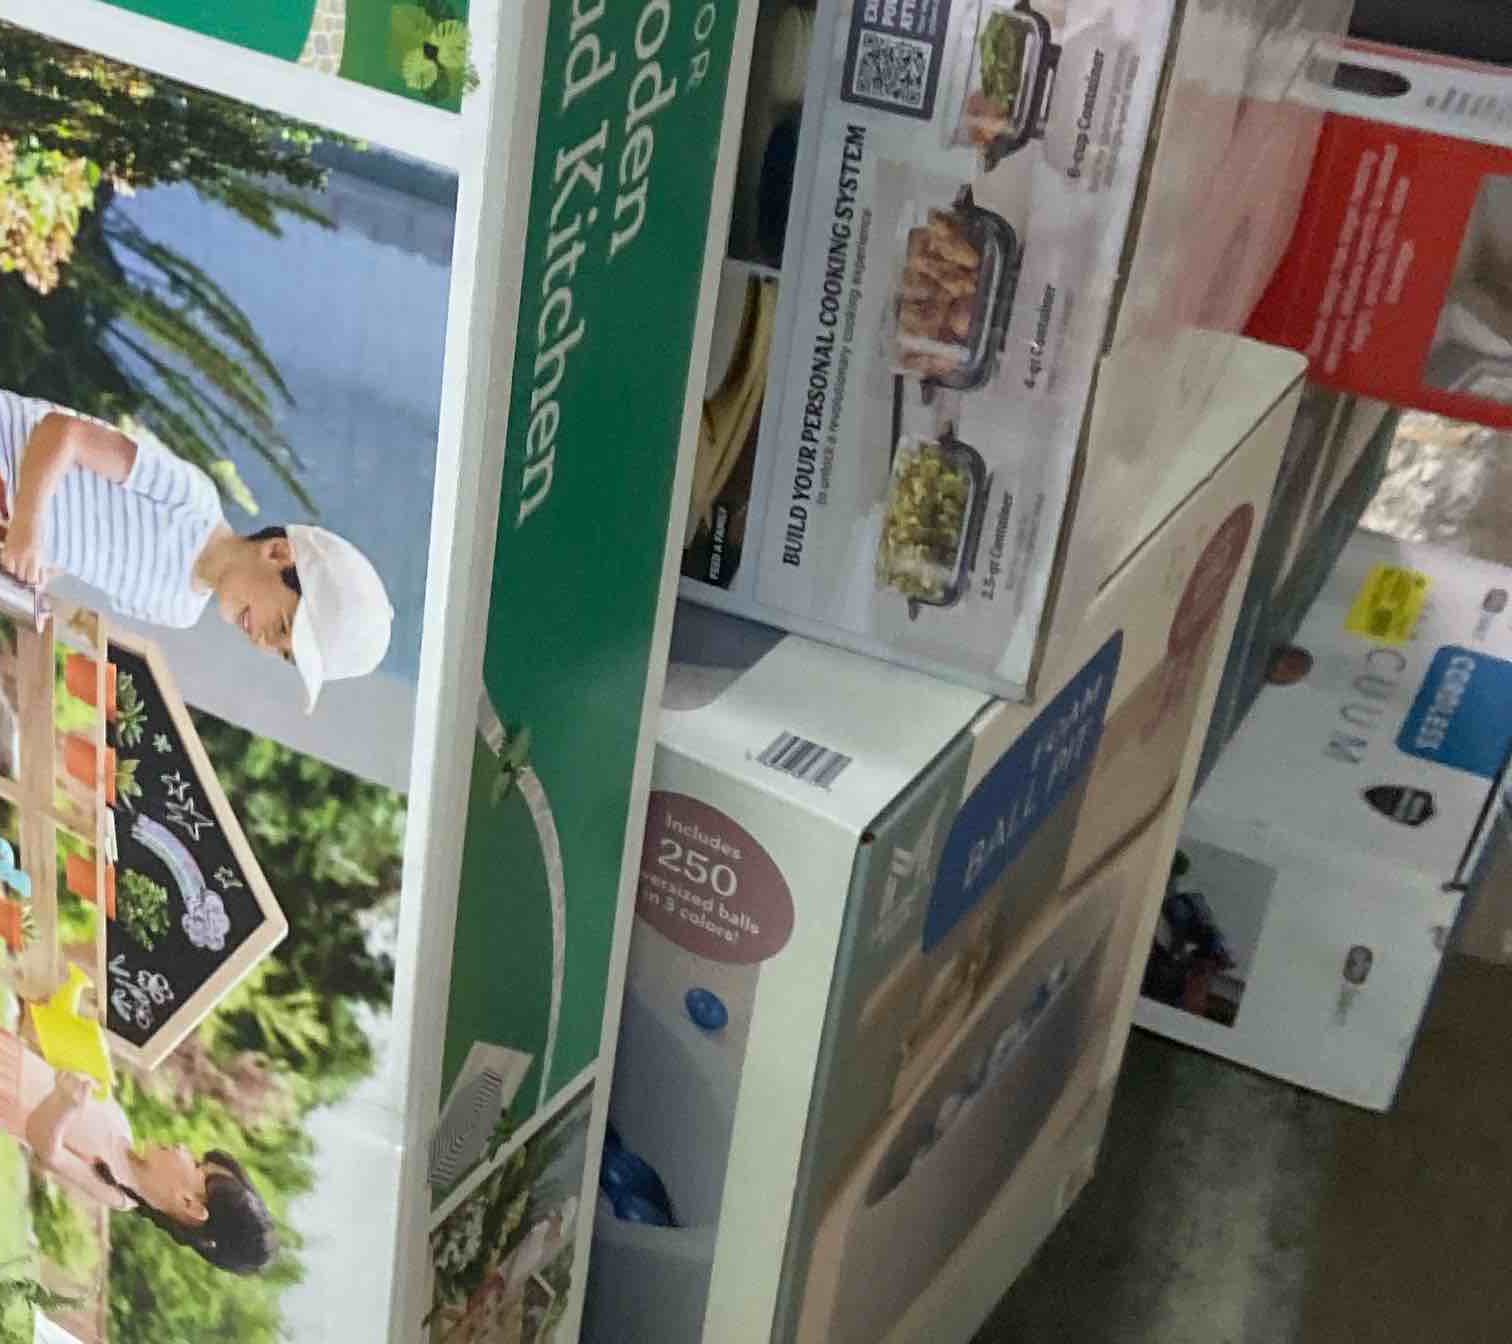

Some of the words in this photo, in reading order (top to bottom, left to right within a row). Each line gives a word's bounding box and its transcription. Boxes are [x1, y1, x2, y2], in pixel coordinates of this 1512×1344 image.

[1076, 49, 1104, 129] Container
[833, 124, 866, 219] SYSTEM
[818, 219, 851, 327] COOKING
[516, 119, 610, 529] Kitchen
[1029, 284, 1057, 356] Container
[801, 334, 835, 443] PERSONAL
[828, 346, 854, 432] revolutionary
[841, 290, 862, 343] cooking
[792, 447, 817, 500] YOUR
[782, 506, 810, 566] BUILD
[658, 837, 737, 897] 250
[664, 812, 743, 860] Includes
[719, 904, 760, 935] balls
